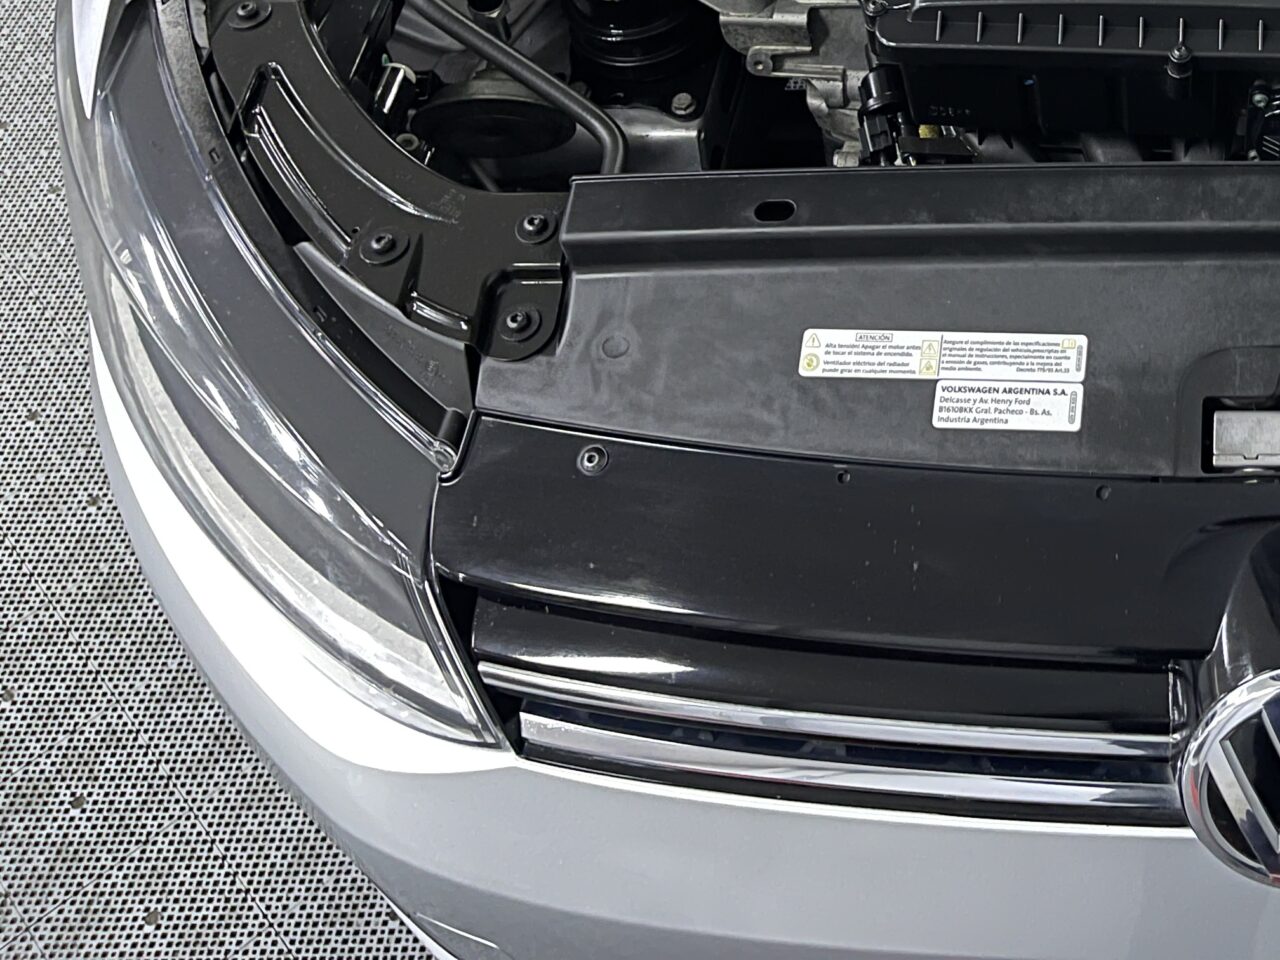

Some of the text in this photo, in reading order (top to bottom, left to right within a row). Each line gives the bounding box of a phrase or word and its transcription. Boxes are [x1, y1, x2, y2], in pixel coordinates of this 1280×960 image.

[941, 385, 1069, 397] VOLKSWAGEN ARGENTINA S.A.
[990, 397, 1013, 407] Henry
[1014, 398, 1031, 406] Ford
[974, 406, 993, 415] Gral.
[993, 407, 1024, 416] Pacheco
[937, 415, 1009, 426] Industria Argentina
